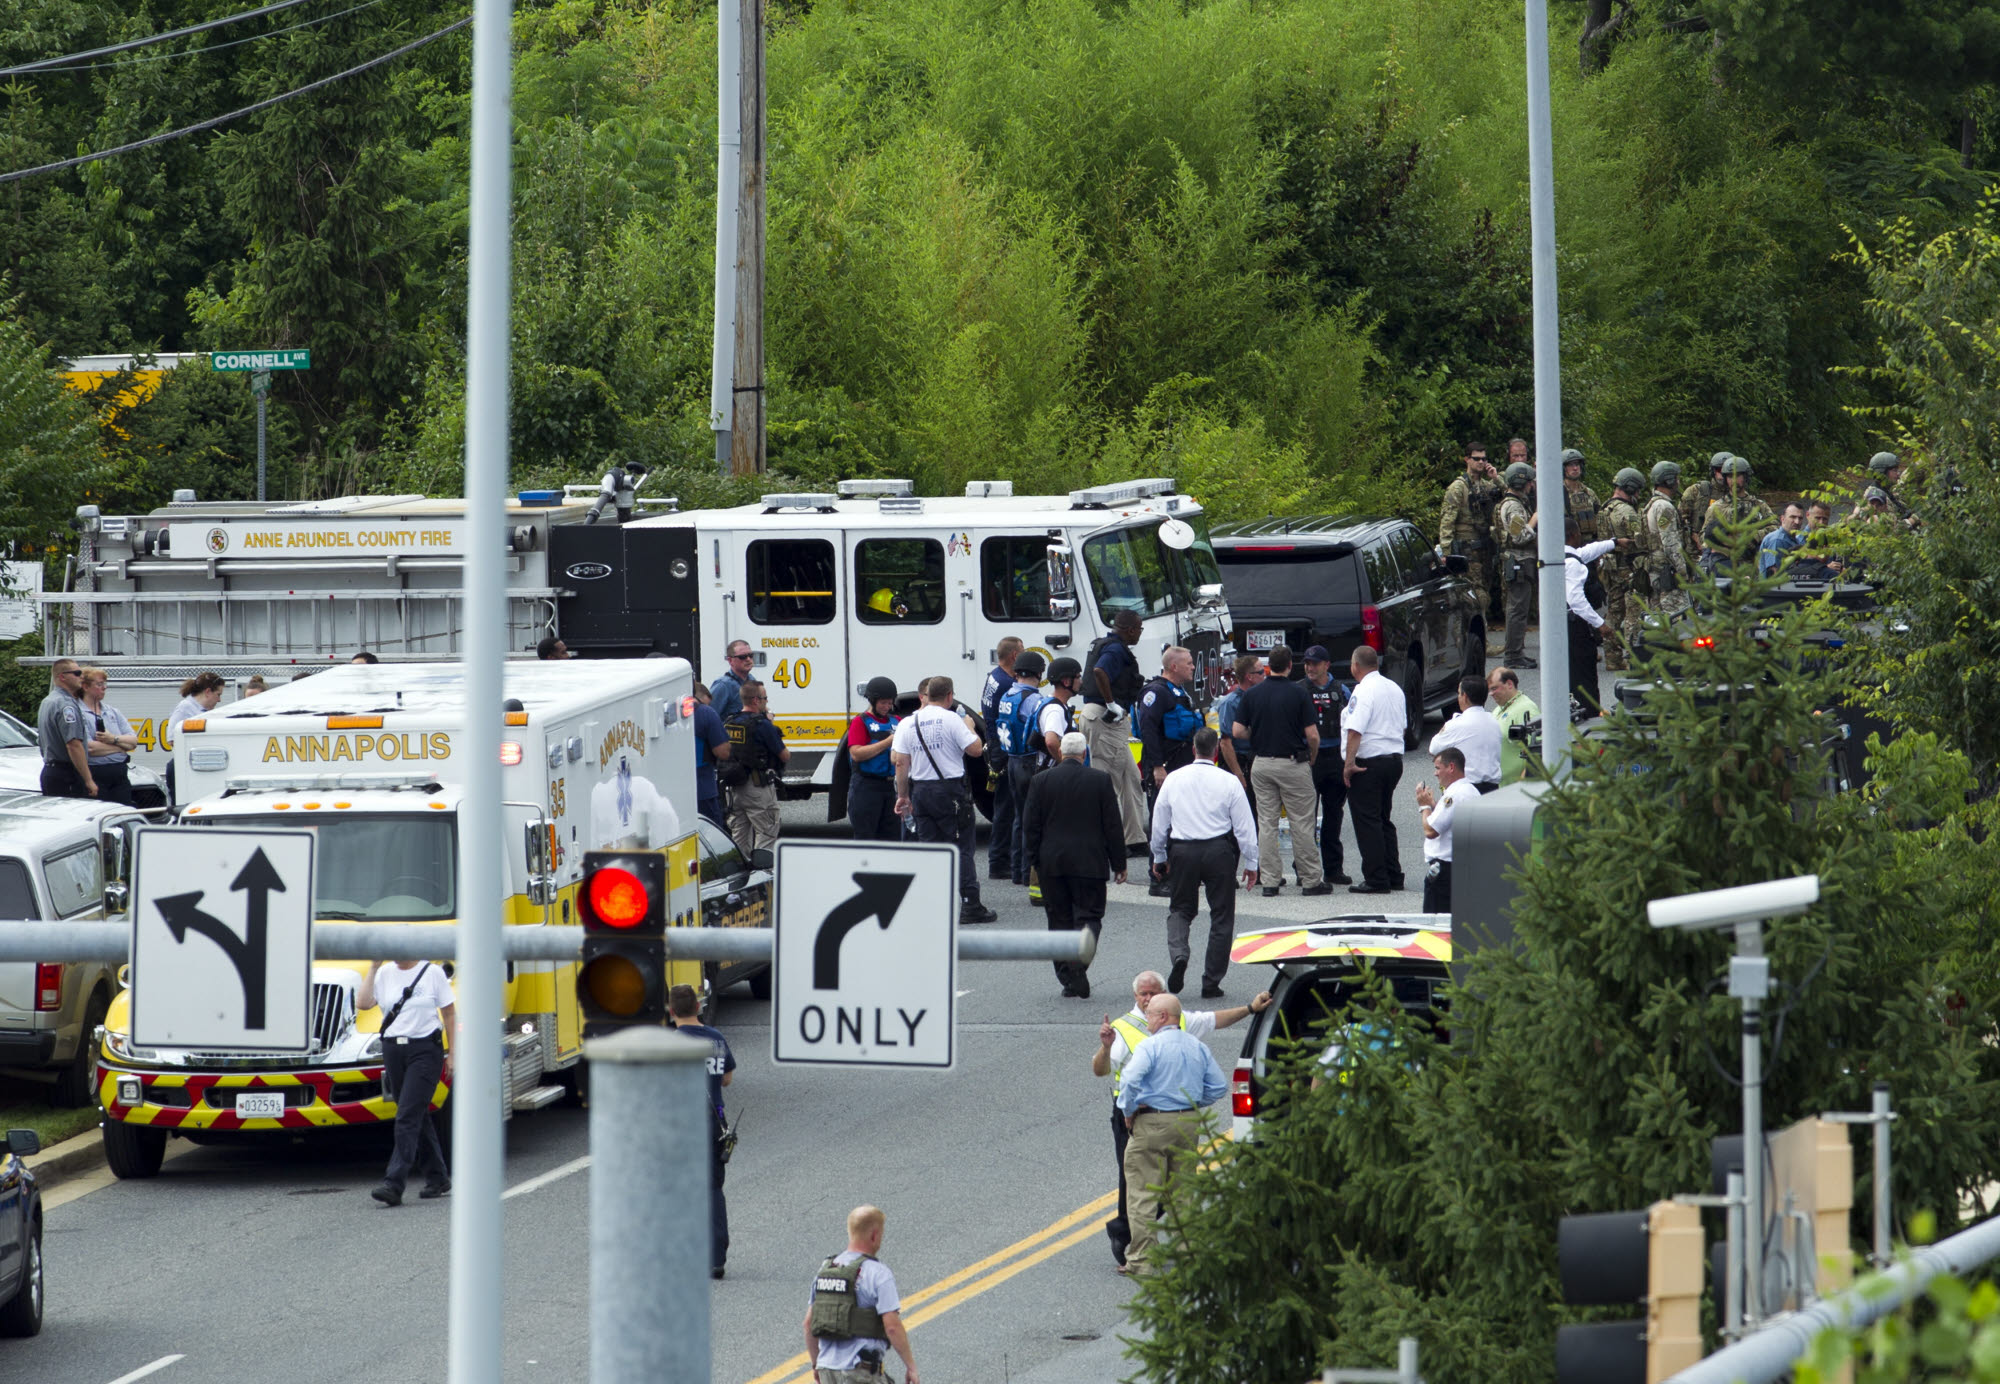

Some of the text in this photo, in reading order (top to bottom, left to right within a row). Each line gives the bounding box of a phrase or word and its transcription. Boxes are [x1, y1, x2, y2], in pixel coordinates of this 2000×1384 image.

[215, 352, 306, 369] CORNELL AVE
[244, 531, 452, 548] ANNE ARUNDEL COUNTY FIRE
[761, 637, 820, 648] ENGINE CO.
[772, 657, 812, 689] 40
[785, 725, 836, 738] To Your Safety
[262, 732, 451, 762] ANNAPOLIS
[600, 720, 645, 773] ANNAPOLIS
[551, 778, 565, 819] 35
[800, 1005, 927, 1047] ONLY
[245, 1099, 275, 1112] 03259
[817, 1278, 846, 1292] TROOPER
